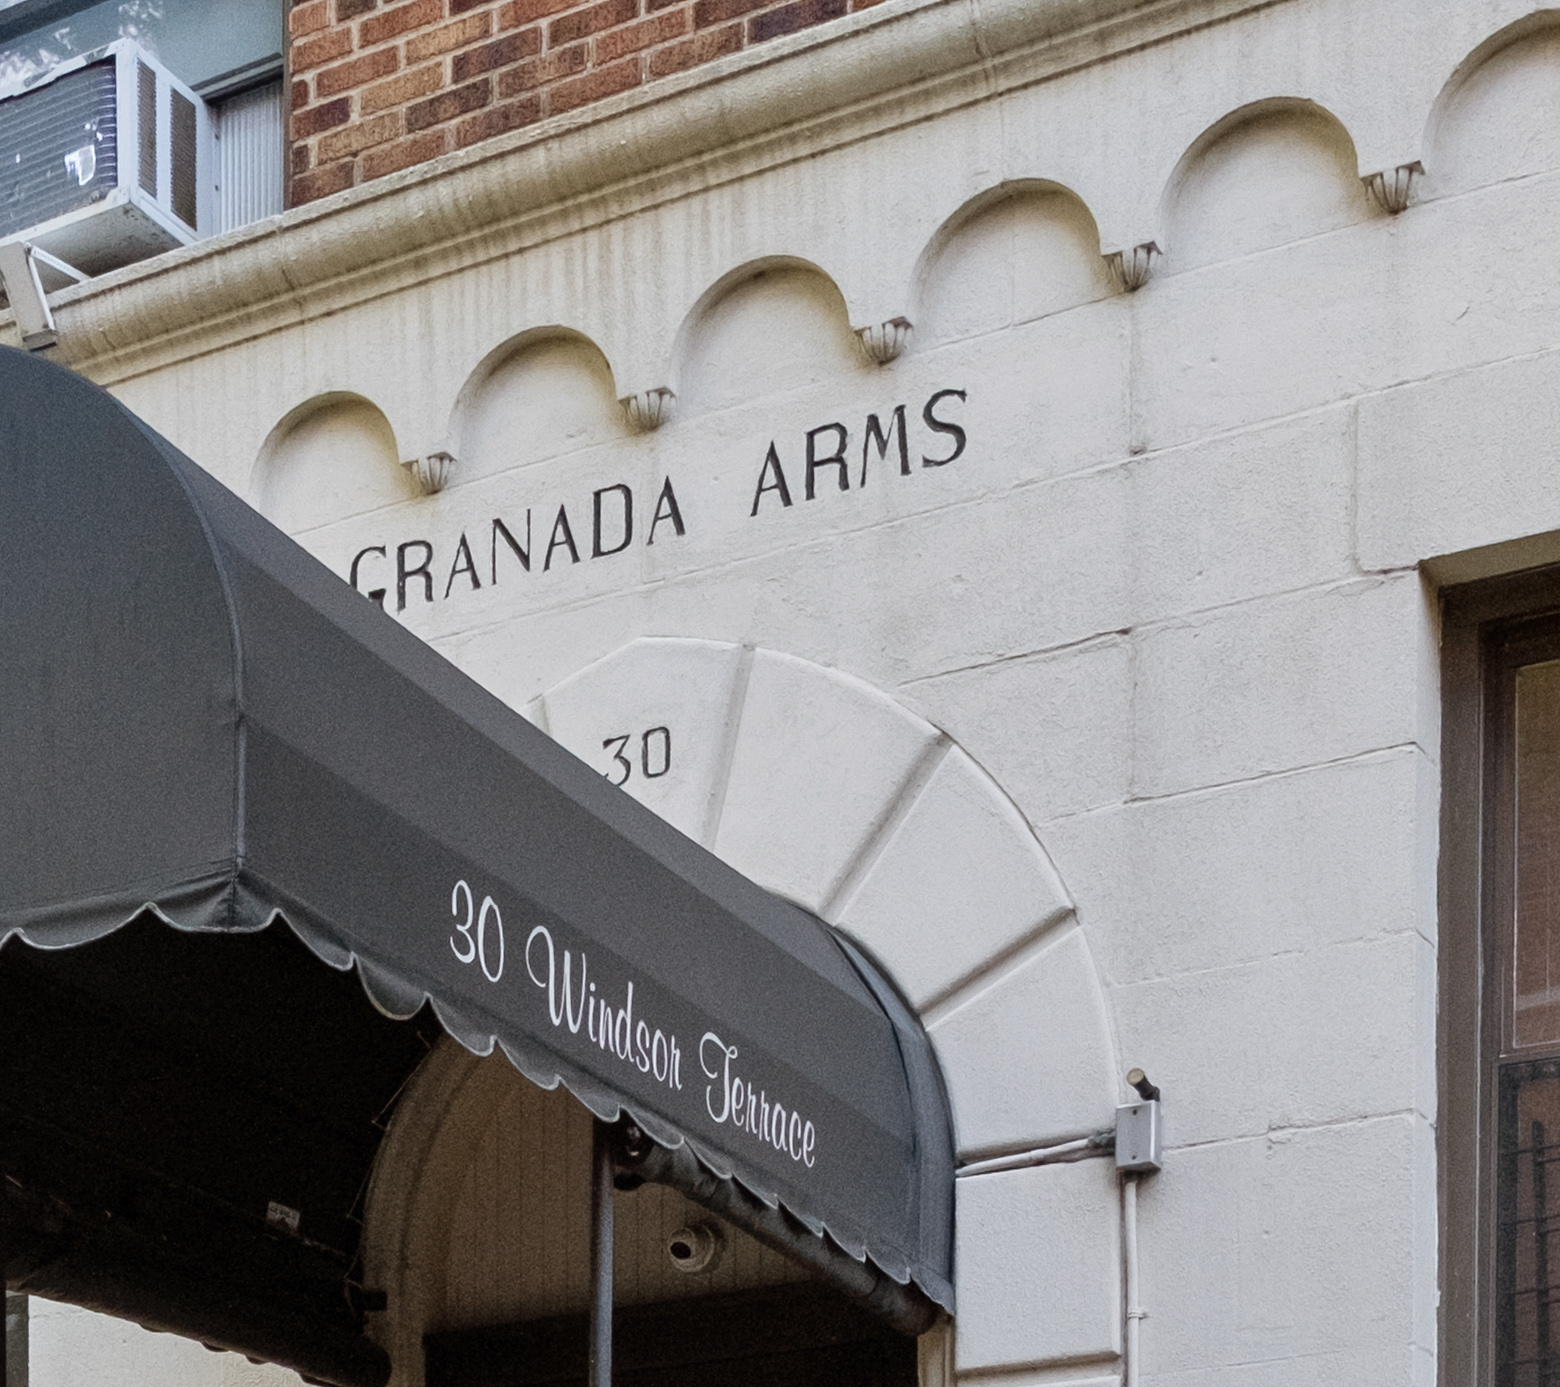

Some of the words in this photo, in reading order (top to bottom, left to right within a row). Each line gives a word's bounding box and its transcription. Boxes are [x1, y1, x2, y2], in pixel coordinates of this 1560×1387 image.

[350, 475, 686, 613] GRANADA
[750, 388, 969, 517] ARMS
[602, 726, 671, 787] 30
[449, 879, 504, 983] 30
[525, 925, 682, 1090] Windsor
[699, 1032, 816, 1168] Terrace
